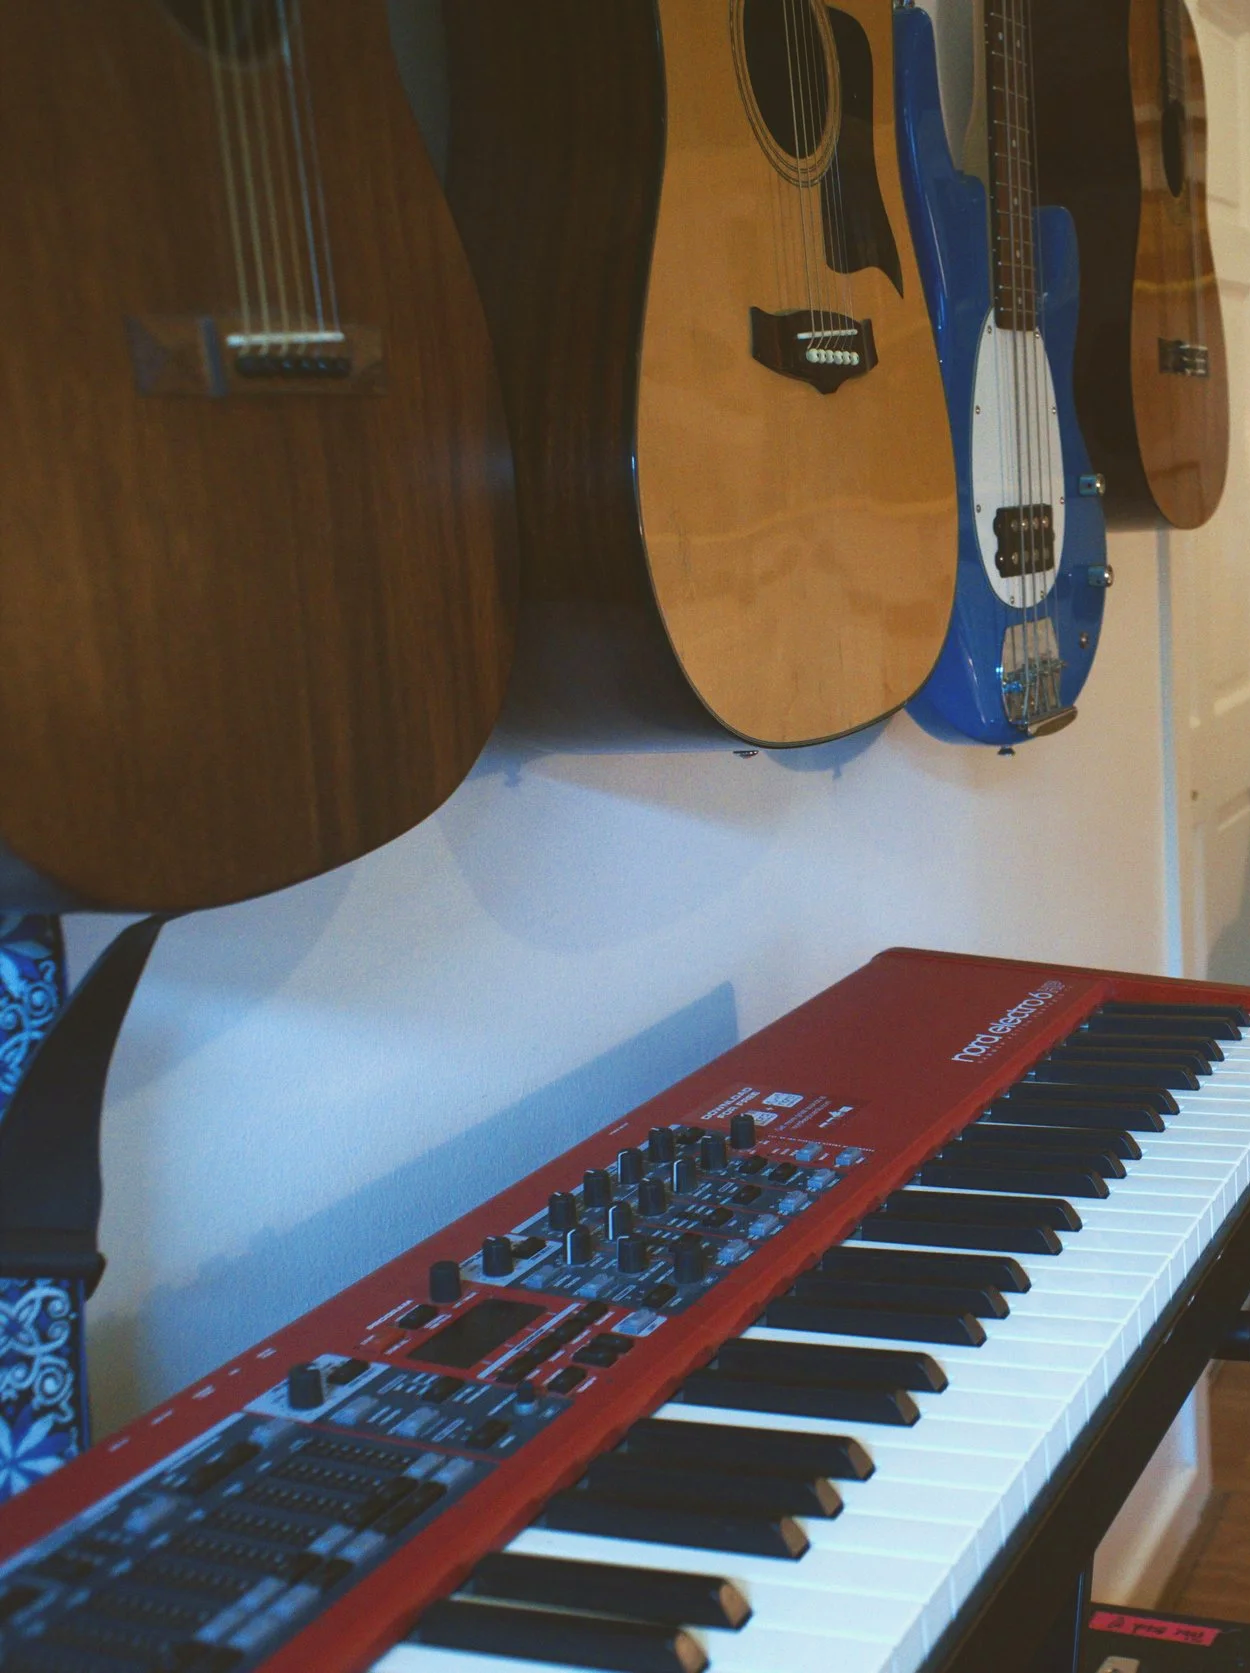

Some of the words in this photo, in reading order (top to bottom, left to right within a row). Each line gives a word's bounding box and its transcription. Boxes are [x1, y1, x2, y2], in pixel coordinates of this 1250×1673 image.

[952, 1033, 1003, 1063] nord
[987, 999, 1045, 1035] electro
[1028, 991, 1053, 1000] 6
[700, 1086, 754, 1120] DOWNLOAD
[716, 1105, 740, 1119] FOR
